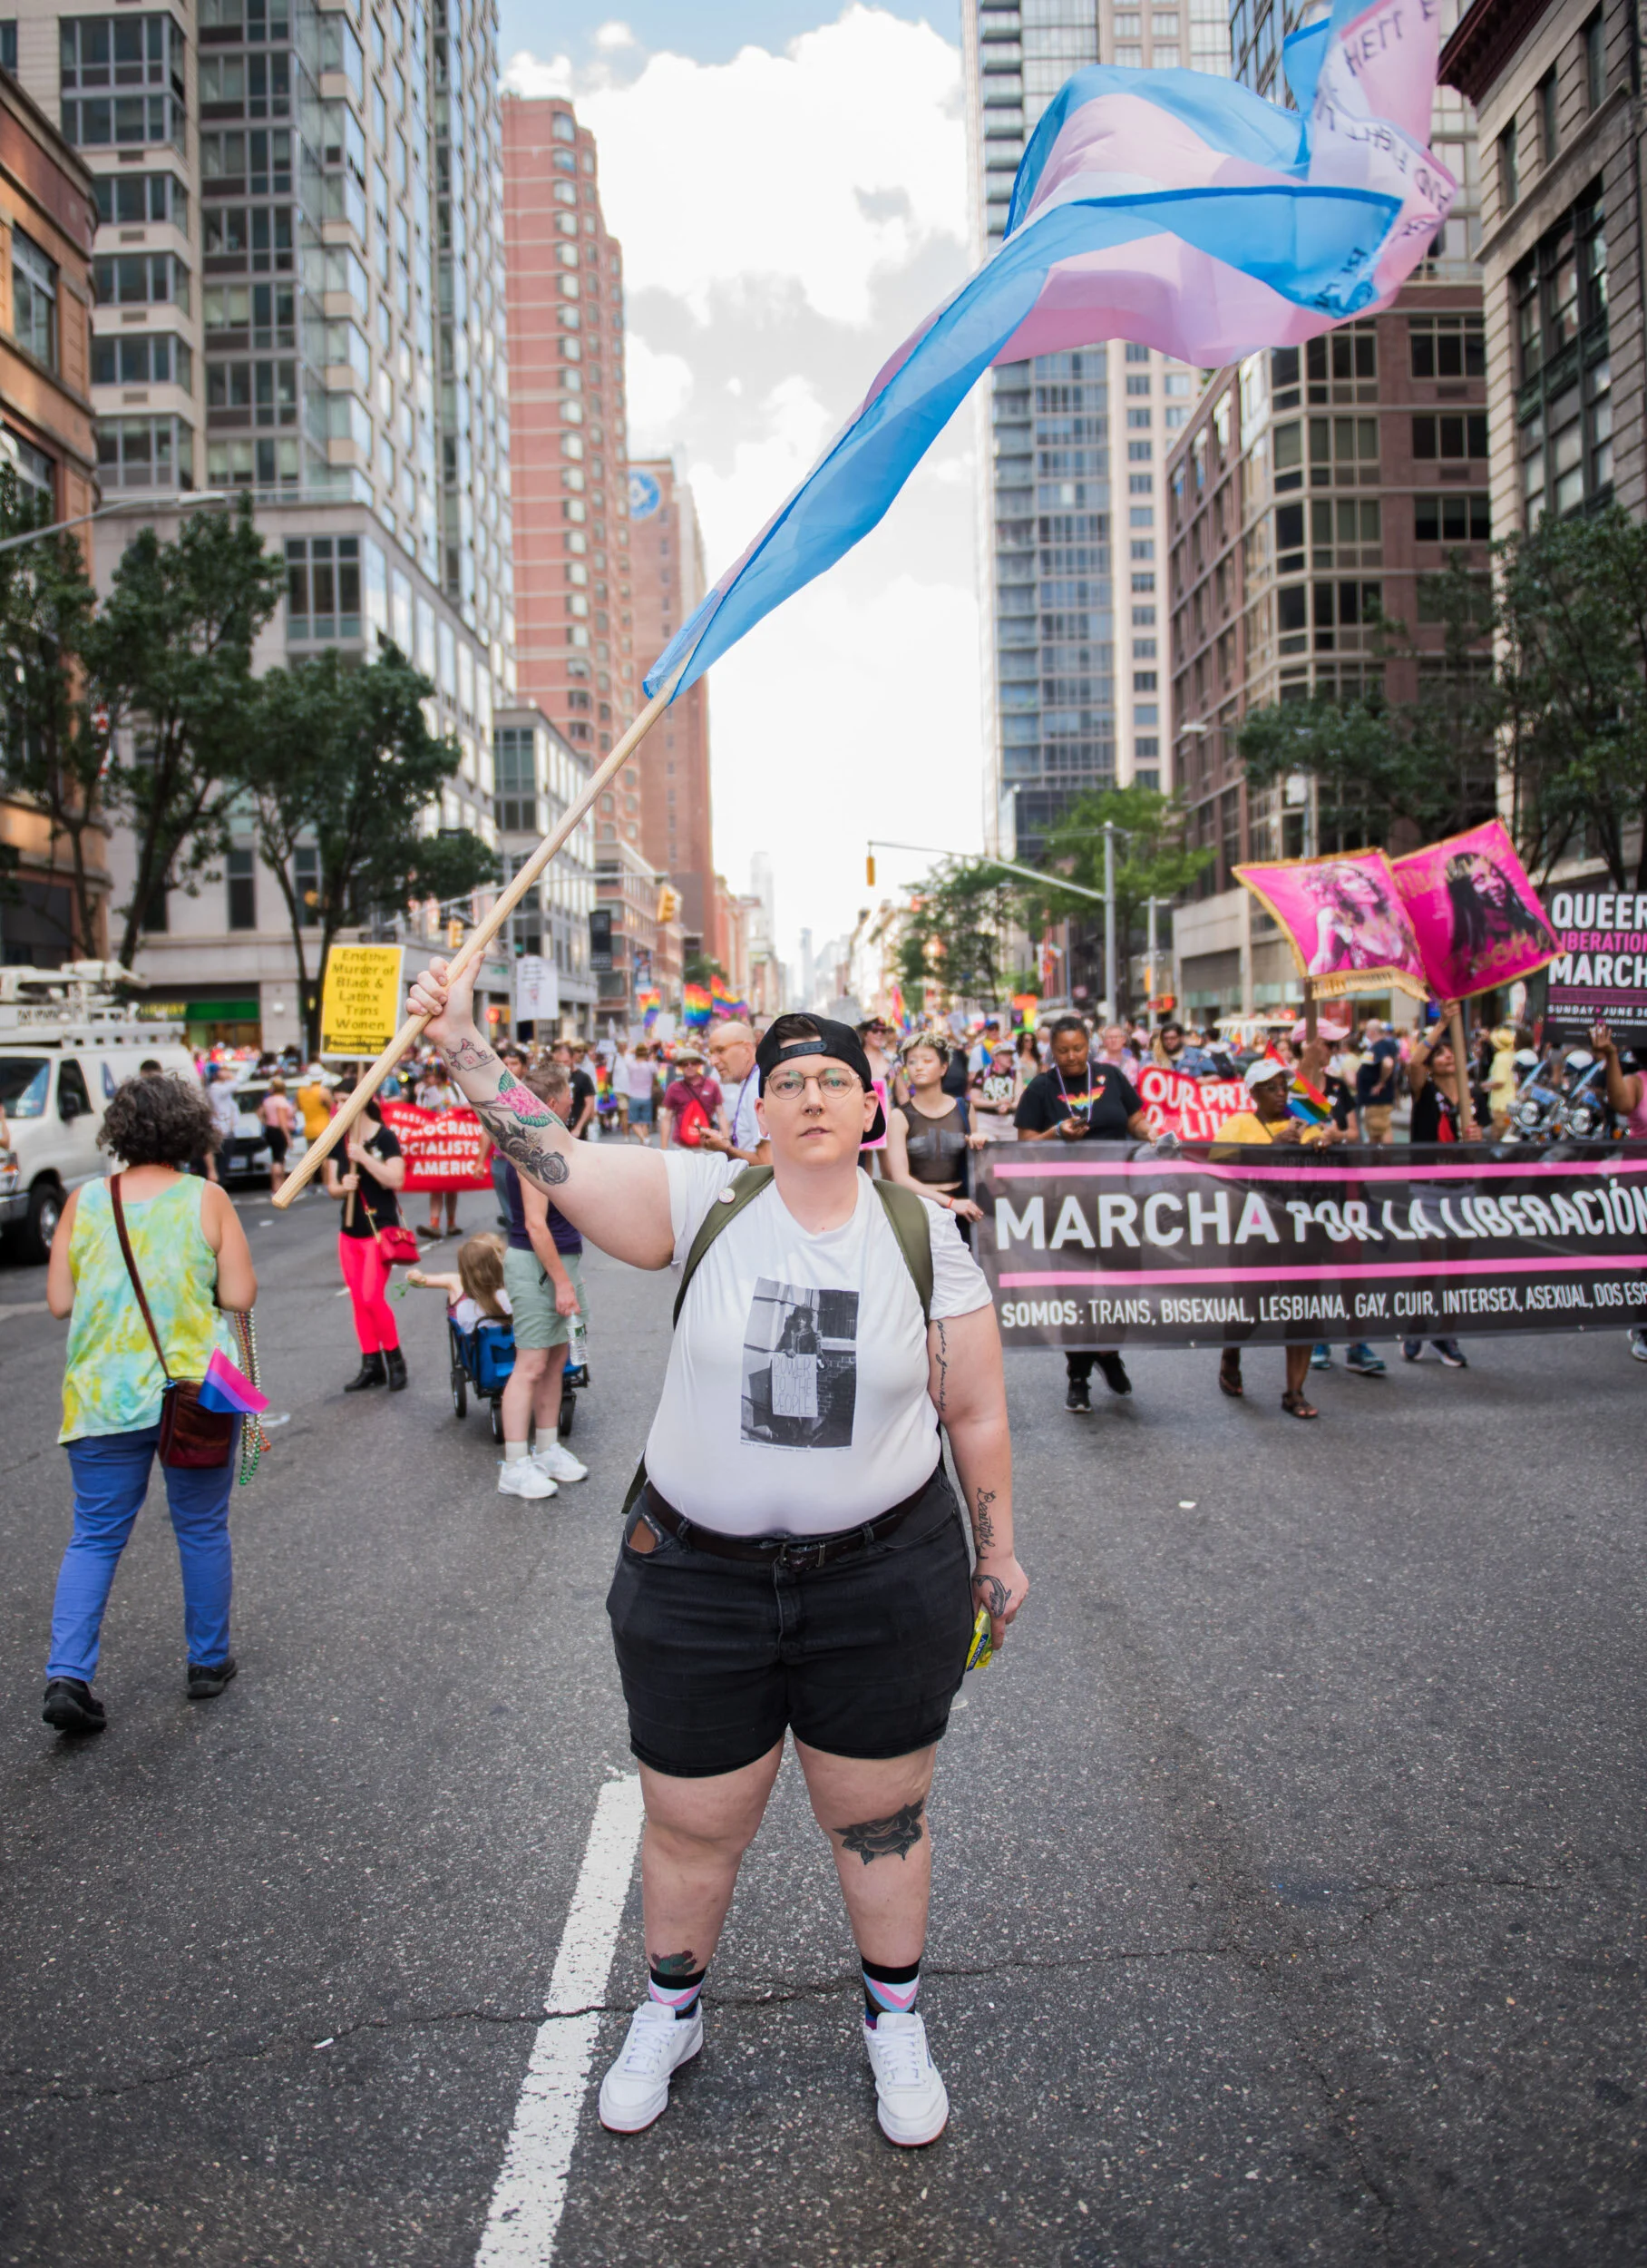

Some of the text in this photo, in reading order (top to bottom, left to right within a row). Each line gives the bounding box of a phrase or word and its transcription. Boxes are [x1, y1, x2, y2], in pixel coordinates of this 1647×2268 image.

[1561, 932, 1647, 953] IBERATIO
[342, 950, 388, 962] End the
[332, 963, 395, 976] Murder of
[336, 976, 384, 989] Black &
[338, 991, 379, 1002] Latinx
[1547, 1005, 1594, 1015] SUNDAY
[1603, 1007, 1633, 1017] JUNE
[336, 1018, 385, 1031] Women
[1142, 1071, 1200, 1111] OUR
[400, 1141, 480, 1156] OCIALISTS
[413, 1161, 487, 1176] AMERIC
[995, 1192, 1279, 1250] MARCHA
[1286, 1200, 1383, 1242] POR
[1382, 1198, 1447, 1240] LA
[1002, 1300, 1085, 1328] SOMOS:
[1088, 1298, 1156, 1326] TRANS,
[1160, 1295, 1255, 1324] BISEXUAL,
[1260, 1293, 1350, 1321] LESBIANA,
[1355, 1292, 1390, 1319] GAY,
[1394, 1291, 1439, 1317] CUIR,
[1444, 1286, 1524, 1314] INTERSEX,
[1525, 1284, 1593, 1310] ASEXUAL,
[1593, 1283, 1623, 1306] DOS
[774, 1354, 812, 1376] POWER
[774, 1374, 812, 1394] TO THE
